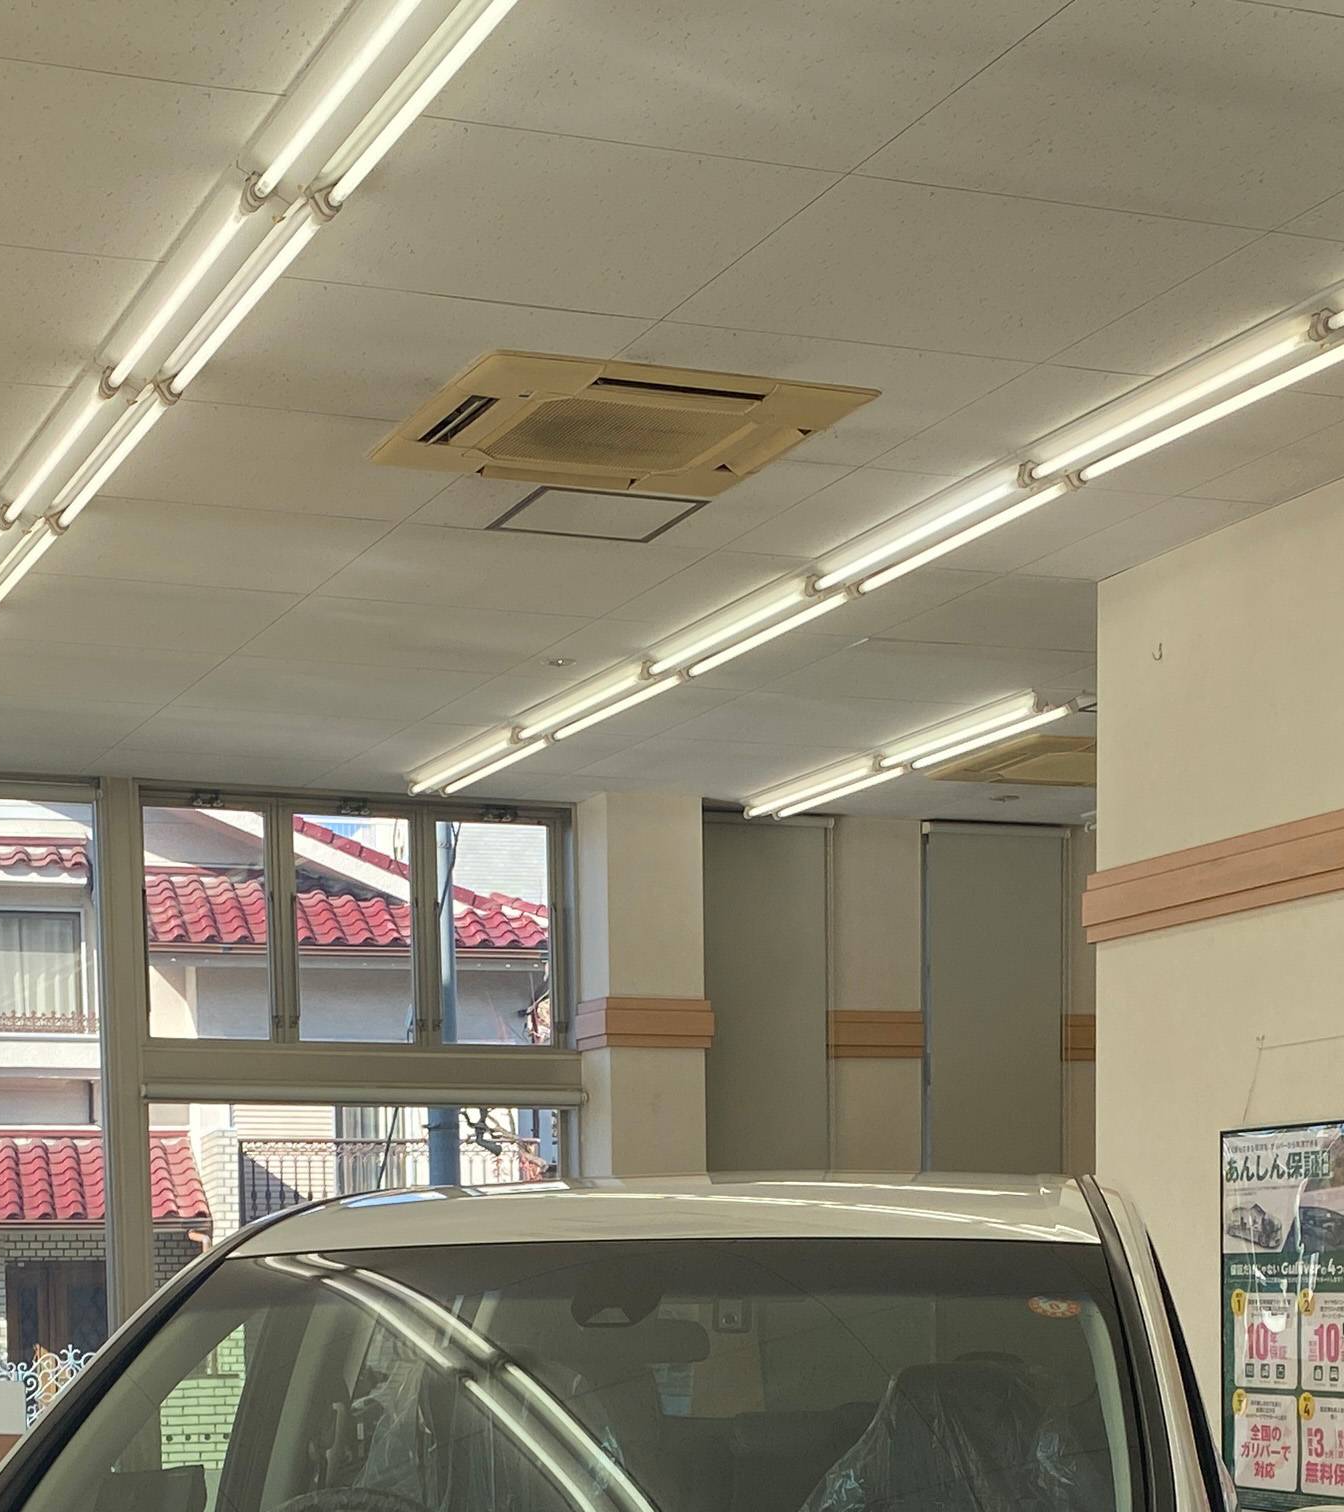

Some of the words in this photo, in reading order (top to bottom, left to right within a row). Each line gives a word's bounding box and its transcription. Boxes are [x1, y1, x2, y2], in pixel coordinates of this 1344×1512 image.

[1247, 1322, 1269, 1360] 10
[1314, 1323, 1340, 1362] 10
[1303, 1404, 1311, 1416] 4
[1250, 1424, 1282, 1442] 全国の
[1241, 1441, 1291, 1462] ガリバーで
[1254, 1461, 1276, 1479] 対応
